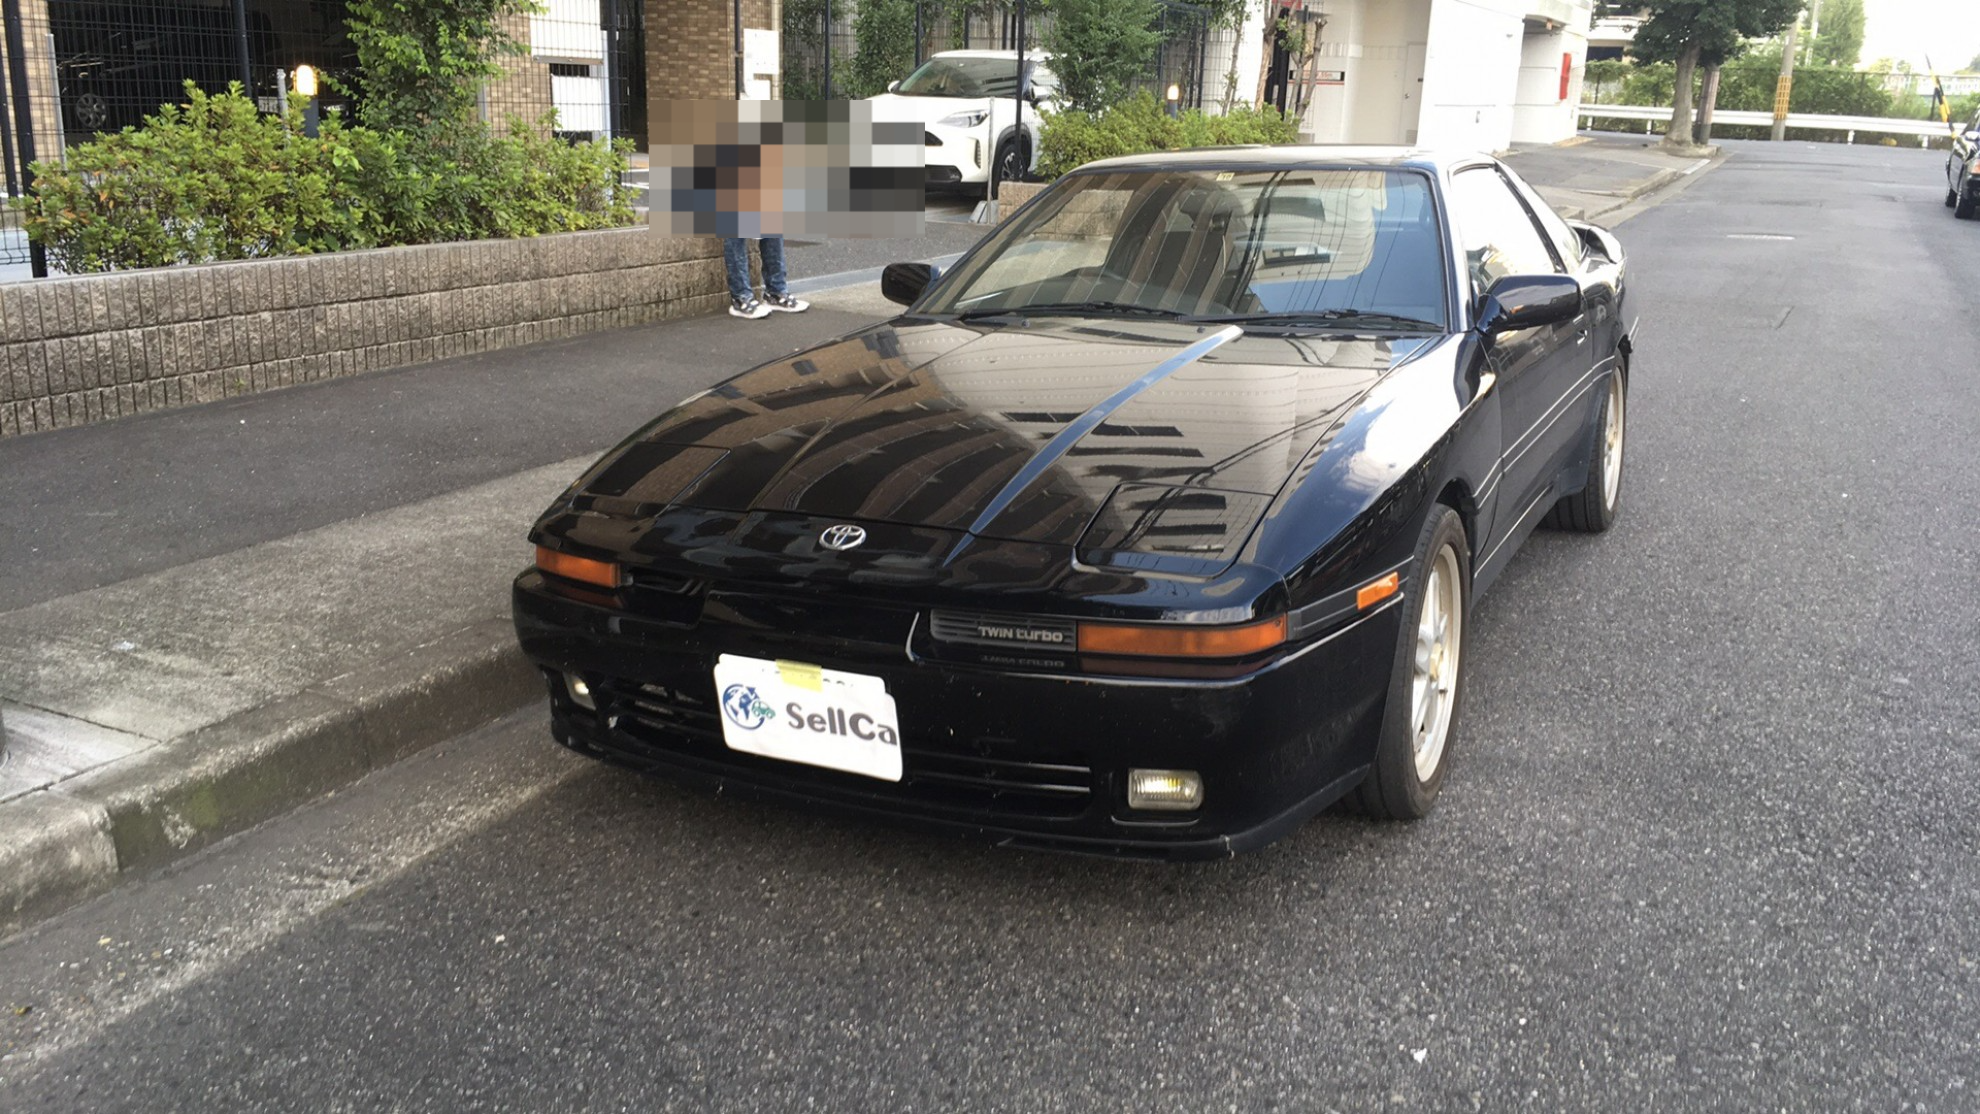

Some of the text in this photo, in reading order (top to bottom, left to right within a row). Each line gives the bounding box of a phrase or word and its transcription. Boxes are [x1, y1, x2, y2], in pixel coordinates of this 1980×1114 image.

[978, 626, 1063, 643] TWIN turbo
[786, 702, 898, 746] SellCa
